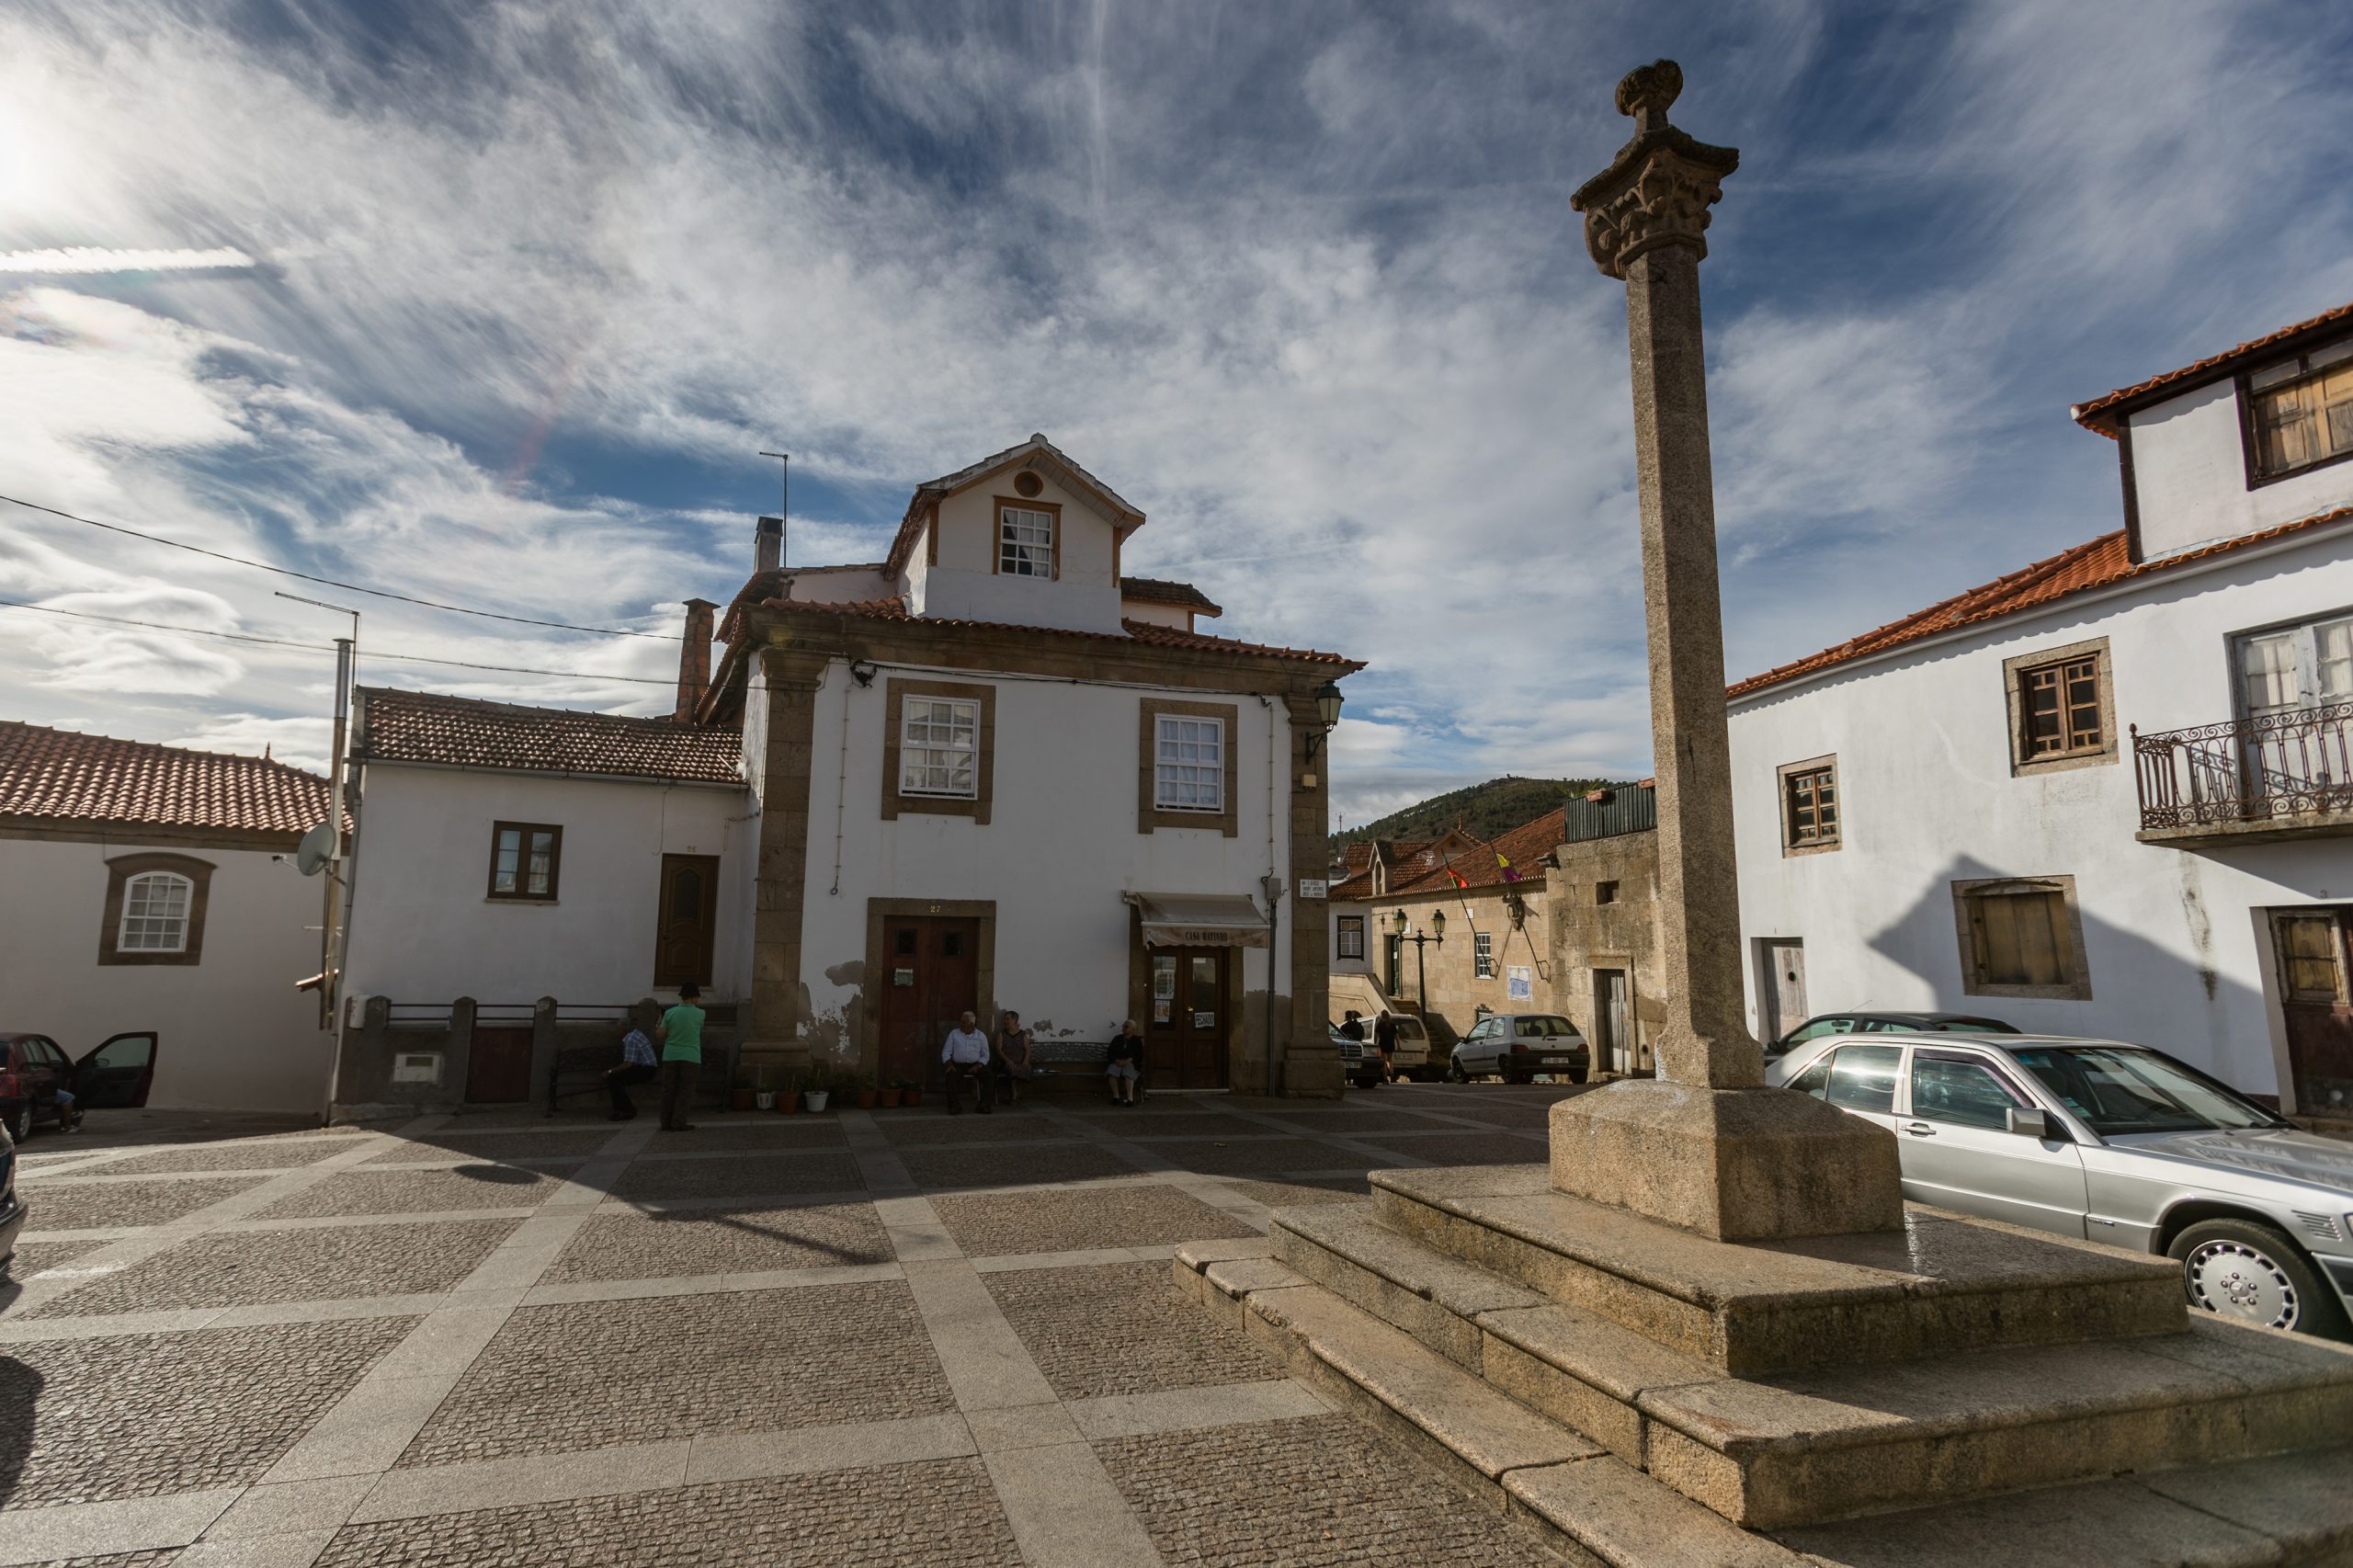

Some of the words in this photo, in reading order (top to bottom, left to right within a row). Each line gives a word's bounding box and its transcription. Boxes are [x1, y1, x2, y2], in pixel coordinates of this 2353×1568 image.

[2320, 889, 2328, 899] 3
[1185, 931, 1199, 941] CASA
[1195, 1014, 1213, 1026] FECHADO
